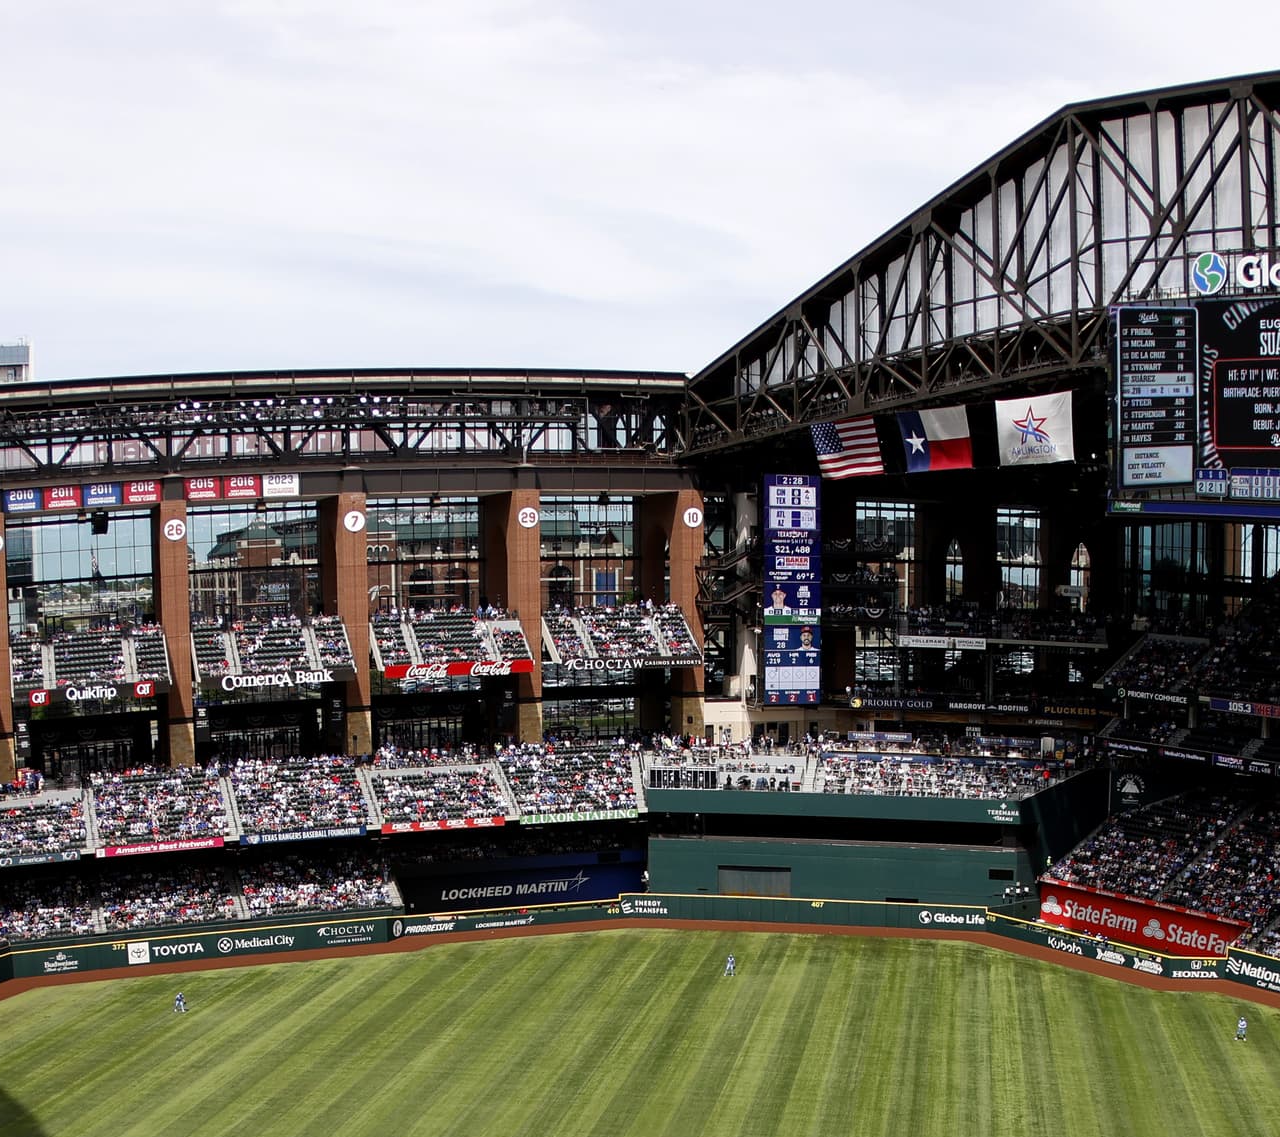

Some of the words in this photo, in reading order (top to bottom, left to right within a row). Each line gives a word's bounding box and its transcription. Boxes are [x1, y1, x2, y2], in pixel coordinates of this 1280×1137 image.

[1131, 363, 1162, 371] STEWART
[1131, 434, 1151, 442] HAYES
[1011, 444, 1056, 456] ARLINGTON
[189, 478, 214, 490] 2015
[230, 476, 255, 487] 2016
[268, 474, 294, 486] 2023
[783, 477, 803, 485] 2:28
[51, 487, 74, 499] 2011
[90, 484, 112, 495] 2011
[130, 481, 155, 493] 2012
[9, 489, 34, 501] 2010
[351, 516, 358, 528] 7
[520, 509, 537, 526] 29
[686, 510, 700, 525] 10
[167, 524, 183, 536] 26
[573, 658, 644, 670] CHOCTAW
[296, 668, 334, 684] Bank
[66, 685, 117, 701] QuikTrip
[136, 683, 151, 696] QT
[32, 691, 47, 705] QT
[862, 698, 904, 708] PRIORITY
[906, 700, 933, 709] GOLD
[1127, 690, 1153, 700] PRIORITY
[1155, 693, 1188, 705] COMMERCE
[949, 702, 986, 710] HARGROVE
[998, 704, 1029, 712] ROOFING
[1044, 705, 1096, 716] PLUCKERS
[1228, 702, 1252, 713] 105.3
[1254, 704, 1271, 716] THE
[530, 813, 573, 824] LUXOR
[576, 809, 636, 821] STAFFING
[987, 809, 1019, 817] TEREMANA
[392, 822, 412, 830] DEX
[419, 821, 439, 829] DEX
[447, 819, 465, 827] DEX
[473, 817, 493, 825] DEX
[262, 833, 277, 843] TEXAS
[278, 832, 301, 841] RANGERS
[302, 831, 326, 840] BASEBALL
[328, 827, 361, 837] FOUNDATION
[115, 844, 157, 854] America's
[159, 842, 177, 850] Best
[178, 838, 214, 849] Network
[19, 855, 46, 864] American
[441, 884, 513, 900] LOCKHEED
[515, 881, 568, 895] MARTIN
[811, 901, 824, 909] 407
[934, 912, 964, 923] Globe
[966, 914, 985, 925] Life
[321, 924, 375, 936] CHOCTAW
[405, 922, 456, 934] PROGRESSIVE
[475, 921, 504, 929] LOCKHEED
[235, 936, 273, 949] Medical
[275, 935, 295, 947] City
[1048, 936, 1083, 955] Kubota
[152, 942, 204, 957] TOYOTA
[44, 960, 78, 969] Budweiser
[1256, 979, 1267, 989] Car
